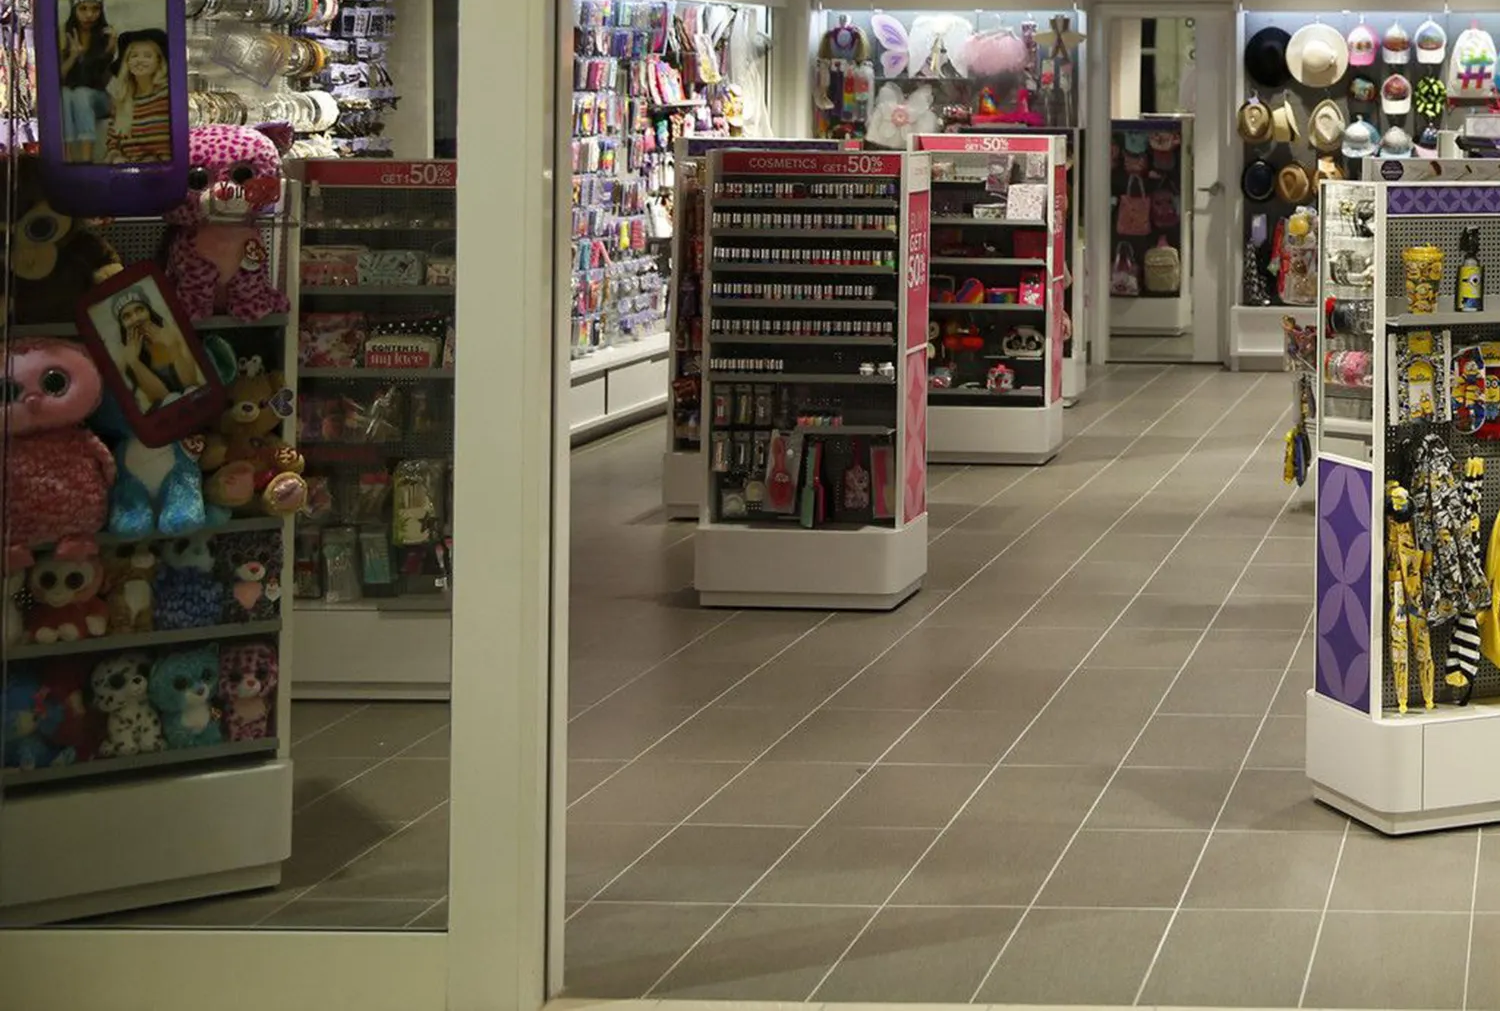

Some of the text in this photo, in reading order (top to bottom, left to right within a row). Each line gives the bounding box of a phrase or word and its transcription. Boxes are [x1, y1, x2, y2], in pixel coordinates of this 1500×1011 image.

[381, 174, 401, 184] GET
[410, 164, 452, 184] 50%
[749, 157, 817, 169] COSMETICS
[847, 155, 883, 174] 50%
